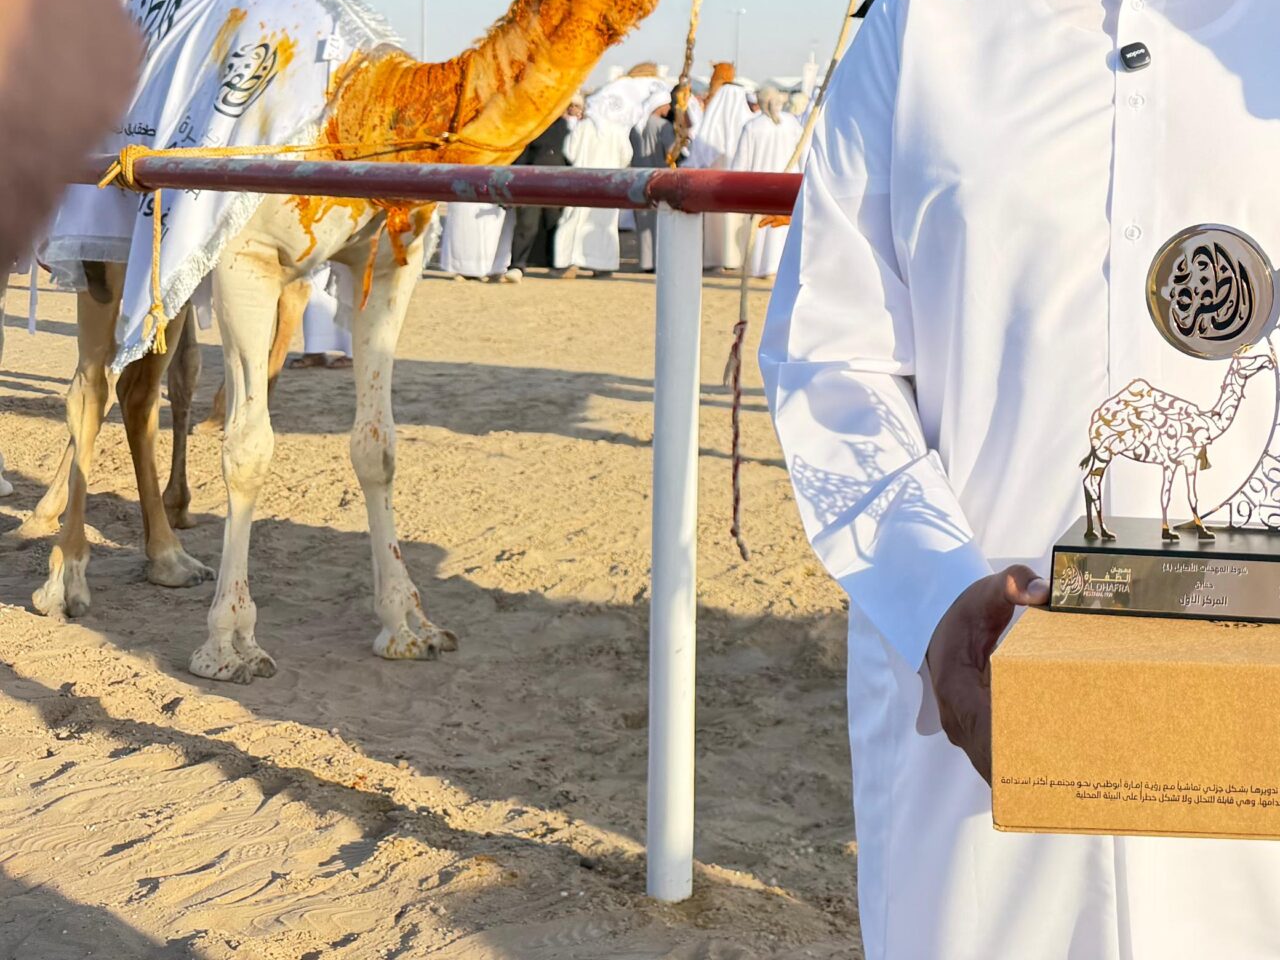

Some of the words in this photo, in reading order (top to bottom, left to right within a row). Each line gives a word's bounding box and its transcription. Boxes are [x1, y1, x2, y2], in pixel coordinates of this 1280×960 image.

[1096, 583, 1130, 593] DHAFRA
[1201, 594, 1229, 609] المركز
[1049, 778, 1075, 788] مجتمع
[1076, 779, 1091, 789] نحو
[1162, 783, 1176, 792] مع
[1122, 791, 1138, 801] على
